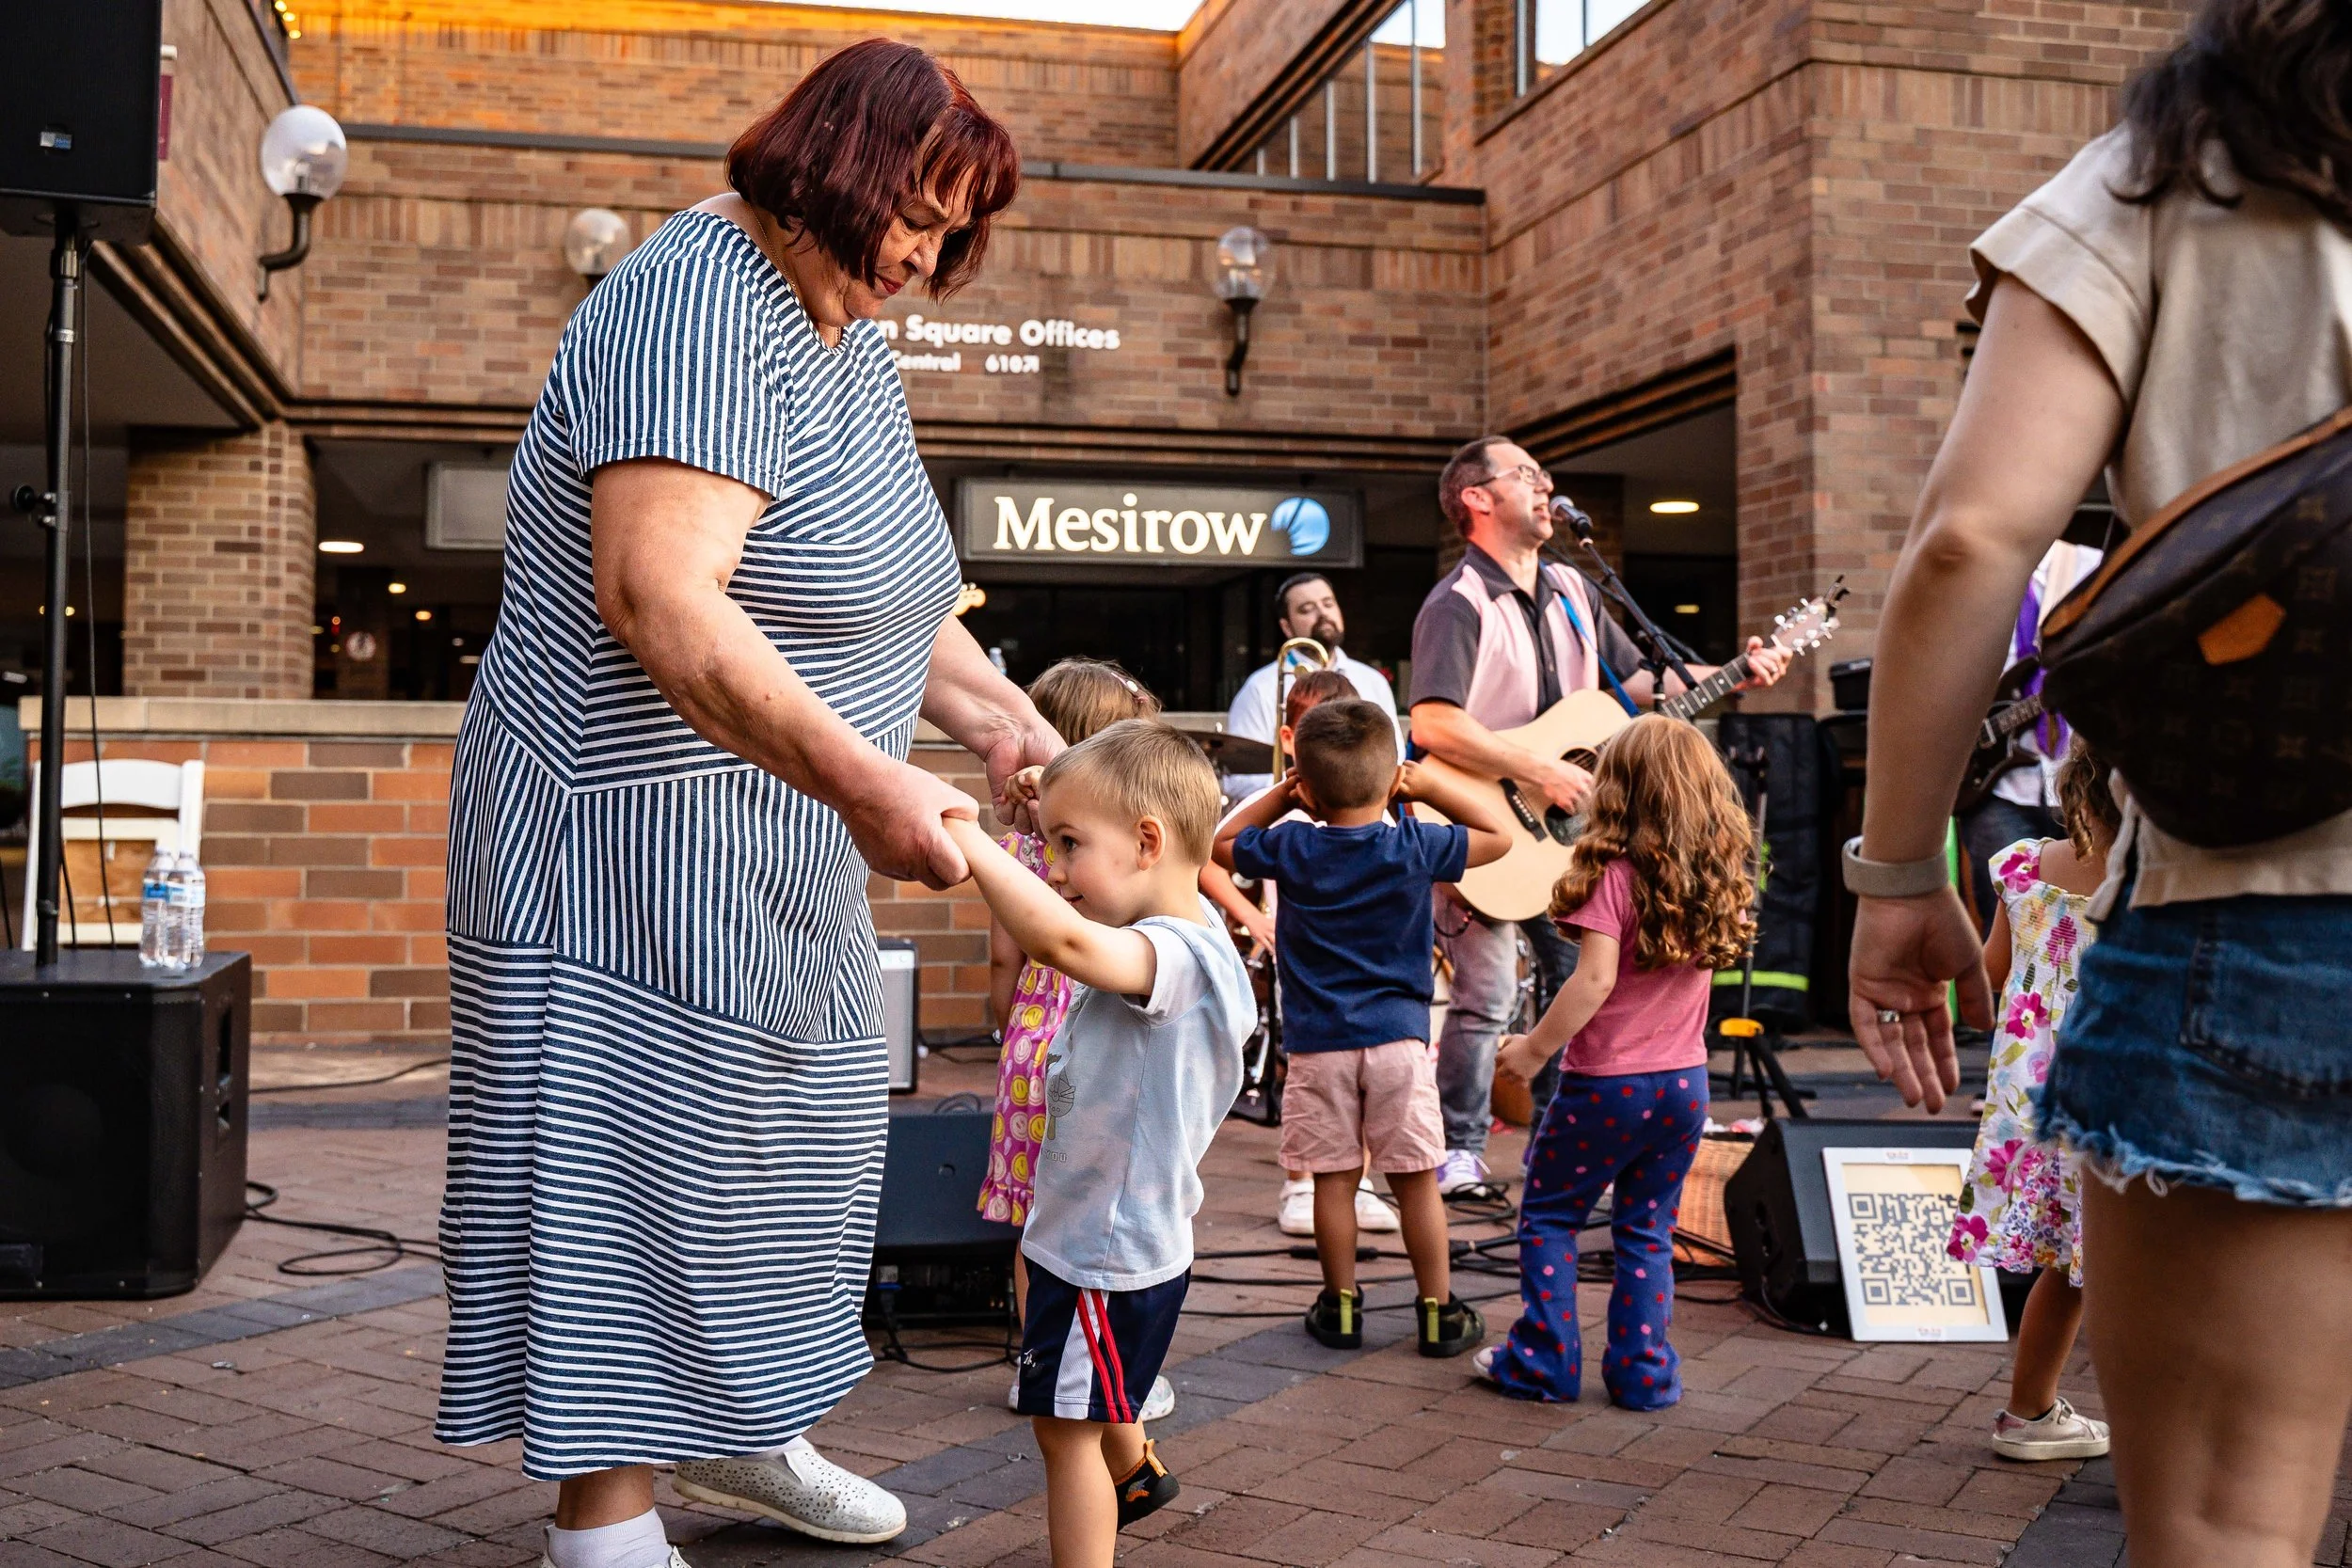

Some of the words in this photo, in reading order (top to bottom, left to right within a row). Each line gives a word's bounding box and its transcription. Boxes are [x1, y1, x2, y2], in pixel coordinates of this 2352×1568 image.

[905, 314, 1012, 348] Square
[1019, 319, 1120, 350] Offices
[993, 492, 1267, 555] Mesirow
